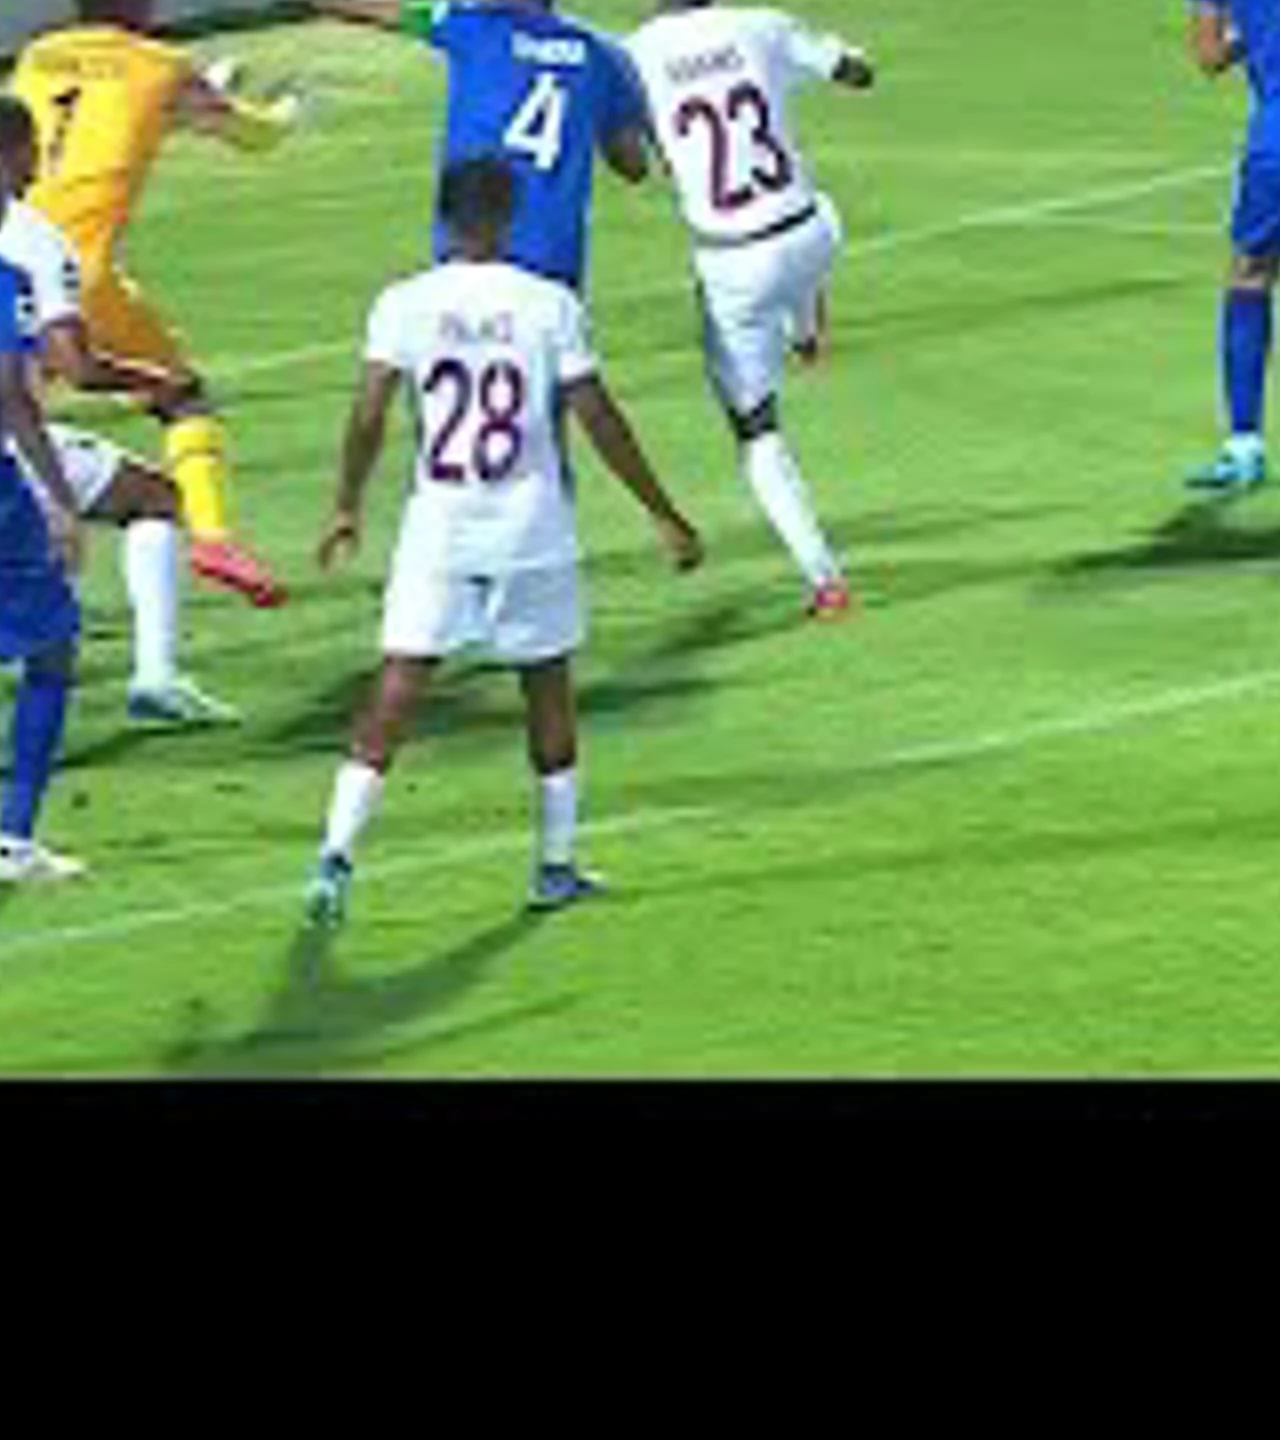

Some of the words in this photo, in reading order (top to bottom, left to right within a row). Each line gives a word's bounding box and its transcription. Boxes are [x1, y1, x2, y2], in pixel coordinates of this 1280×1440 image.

[503, 71, 569, 171] 4
[673, 81, 794, 212] 23
[422, 358, 525, 483] 28
